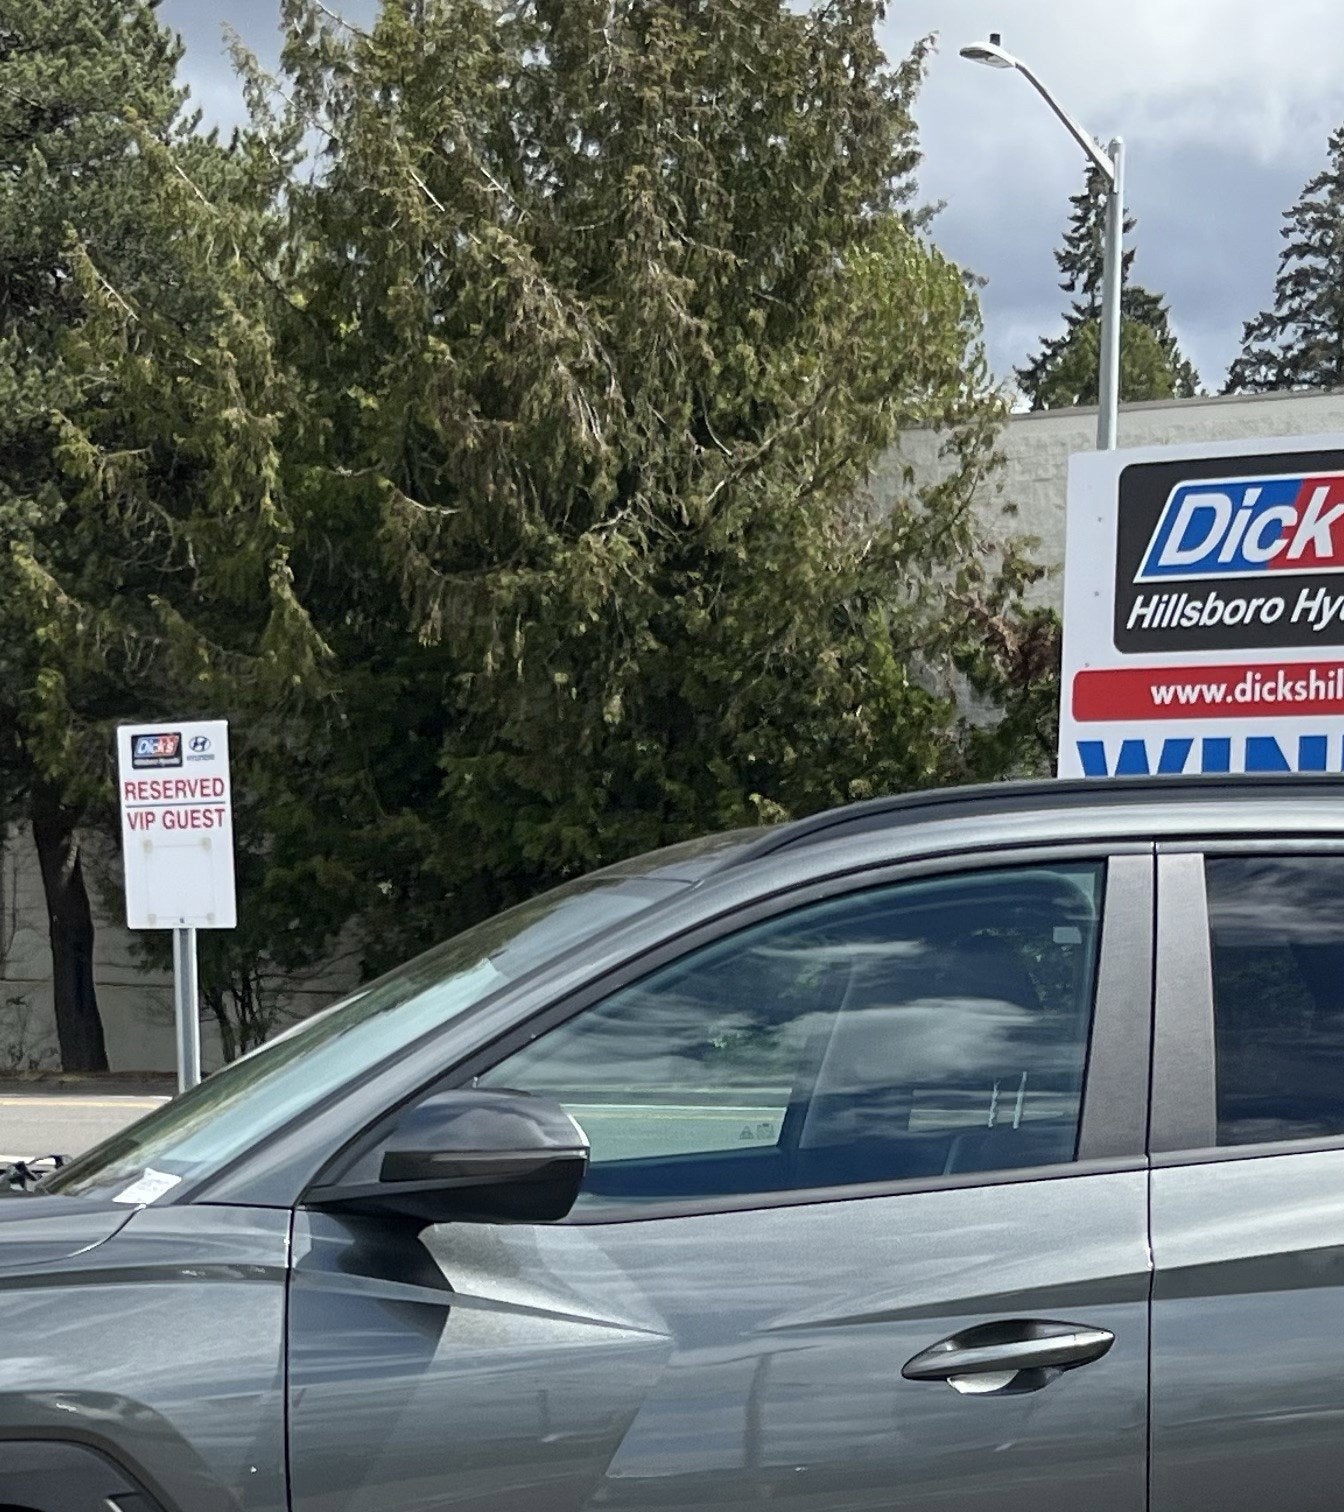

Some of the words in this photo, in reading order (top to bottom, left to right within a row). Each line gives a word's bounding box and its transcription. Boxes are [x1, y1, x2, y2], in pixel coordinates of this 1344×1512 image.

[1125, 591, 1285, 631] Hillsboro
[124, 777, 225, 801] RESERVED
[126, 811, 155, 831] VIP
[162, 808, 226, 830] GUEST
